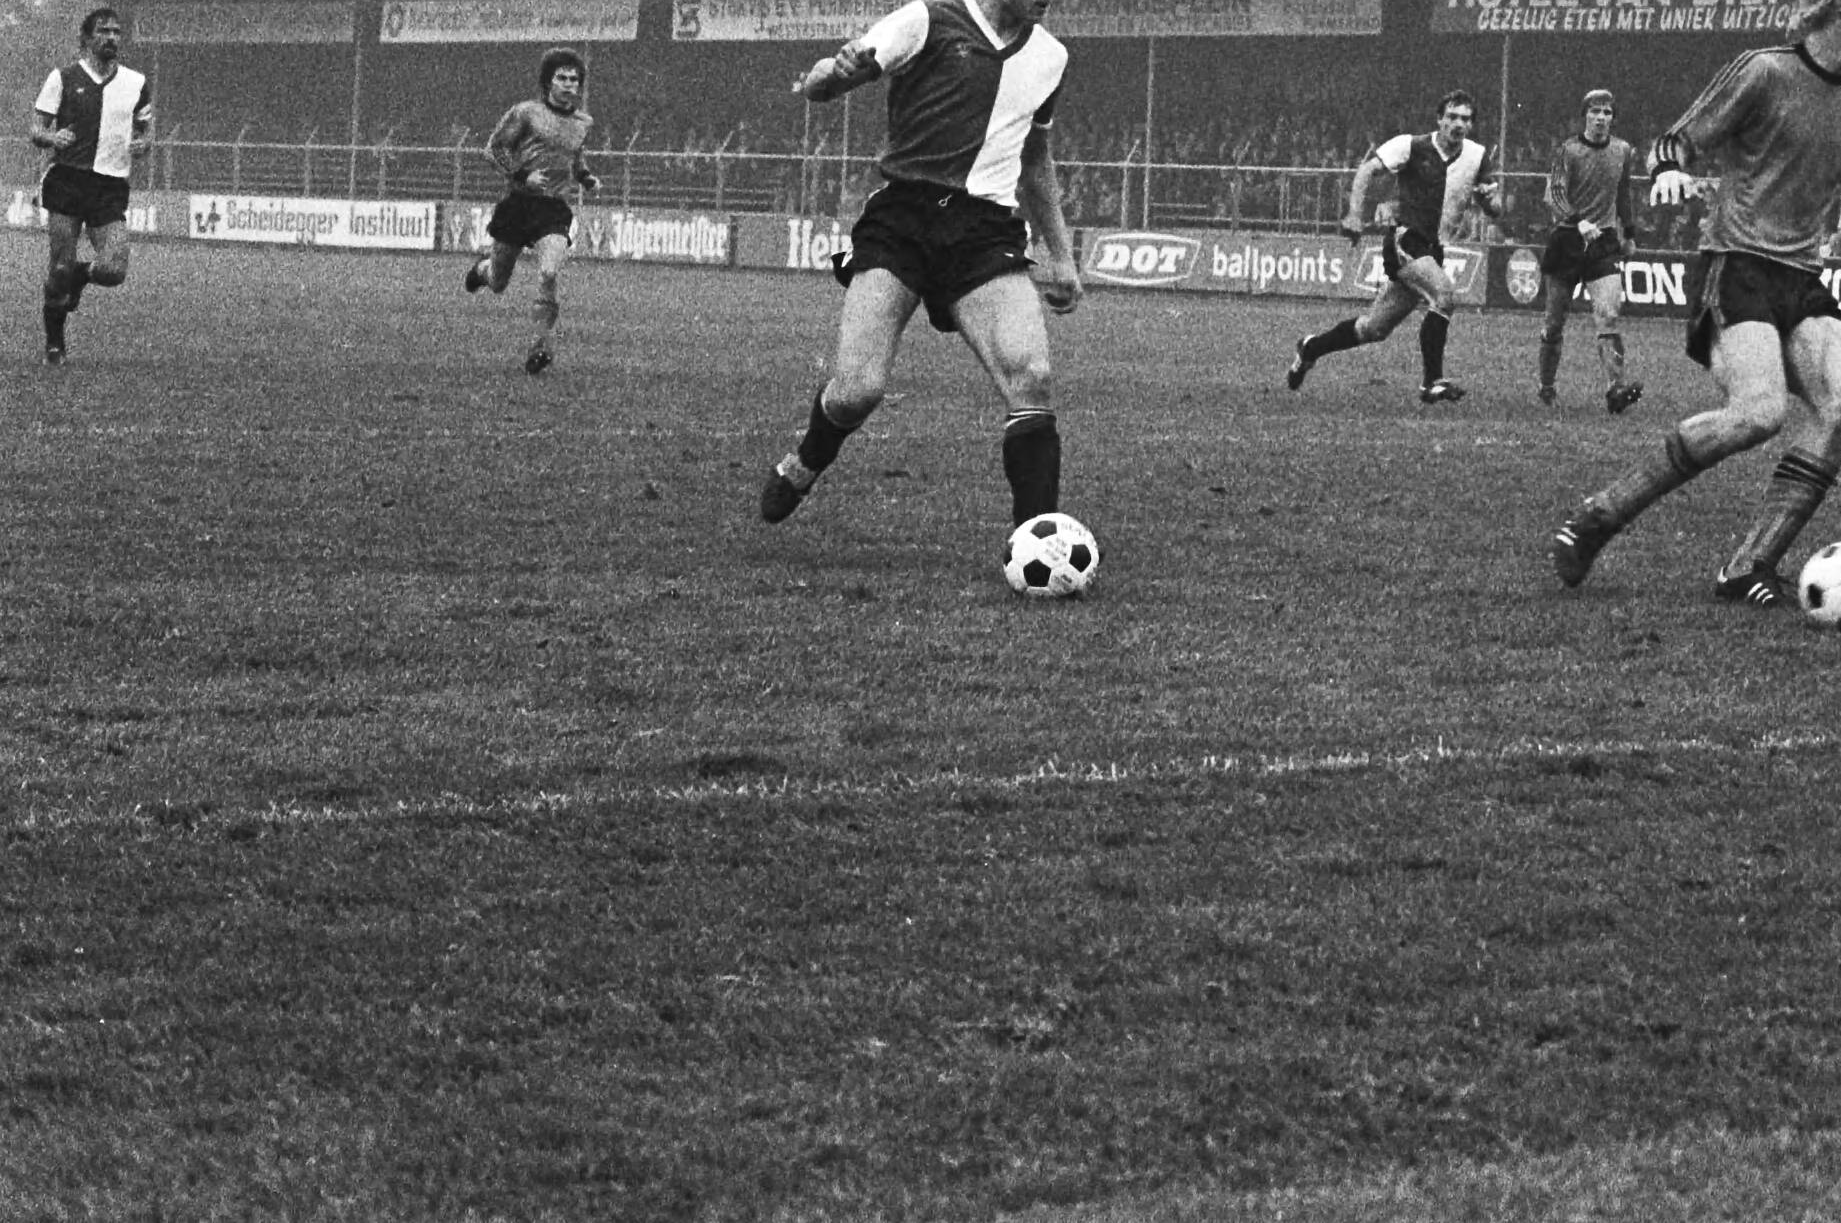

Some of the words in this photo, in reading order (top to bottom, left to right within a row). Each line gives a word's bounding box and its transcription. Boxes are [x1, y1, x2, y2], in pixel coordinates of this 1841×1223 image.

[1564, 7, 1611, 29] ETEN
[1616, 7, 1656, 30] MET
[1660, 6, 1717, 29] UNIEK
[1102, 244, 1187, 274] DOT
[1212, 245, 1343, 288] ballpoints
